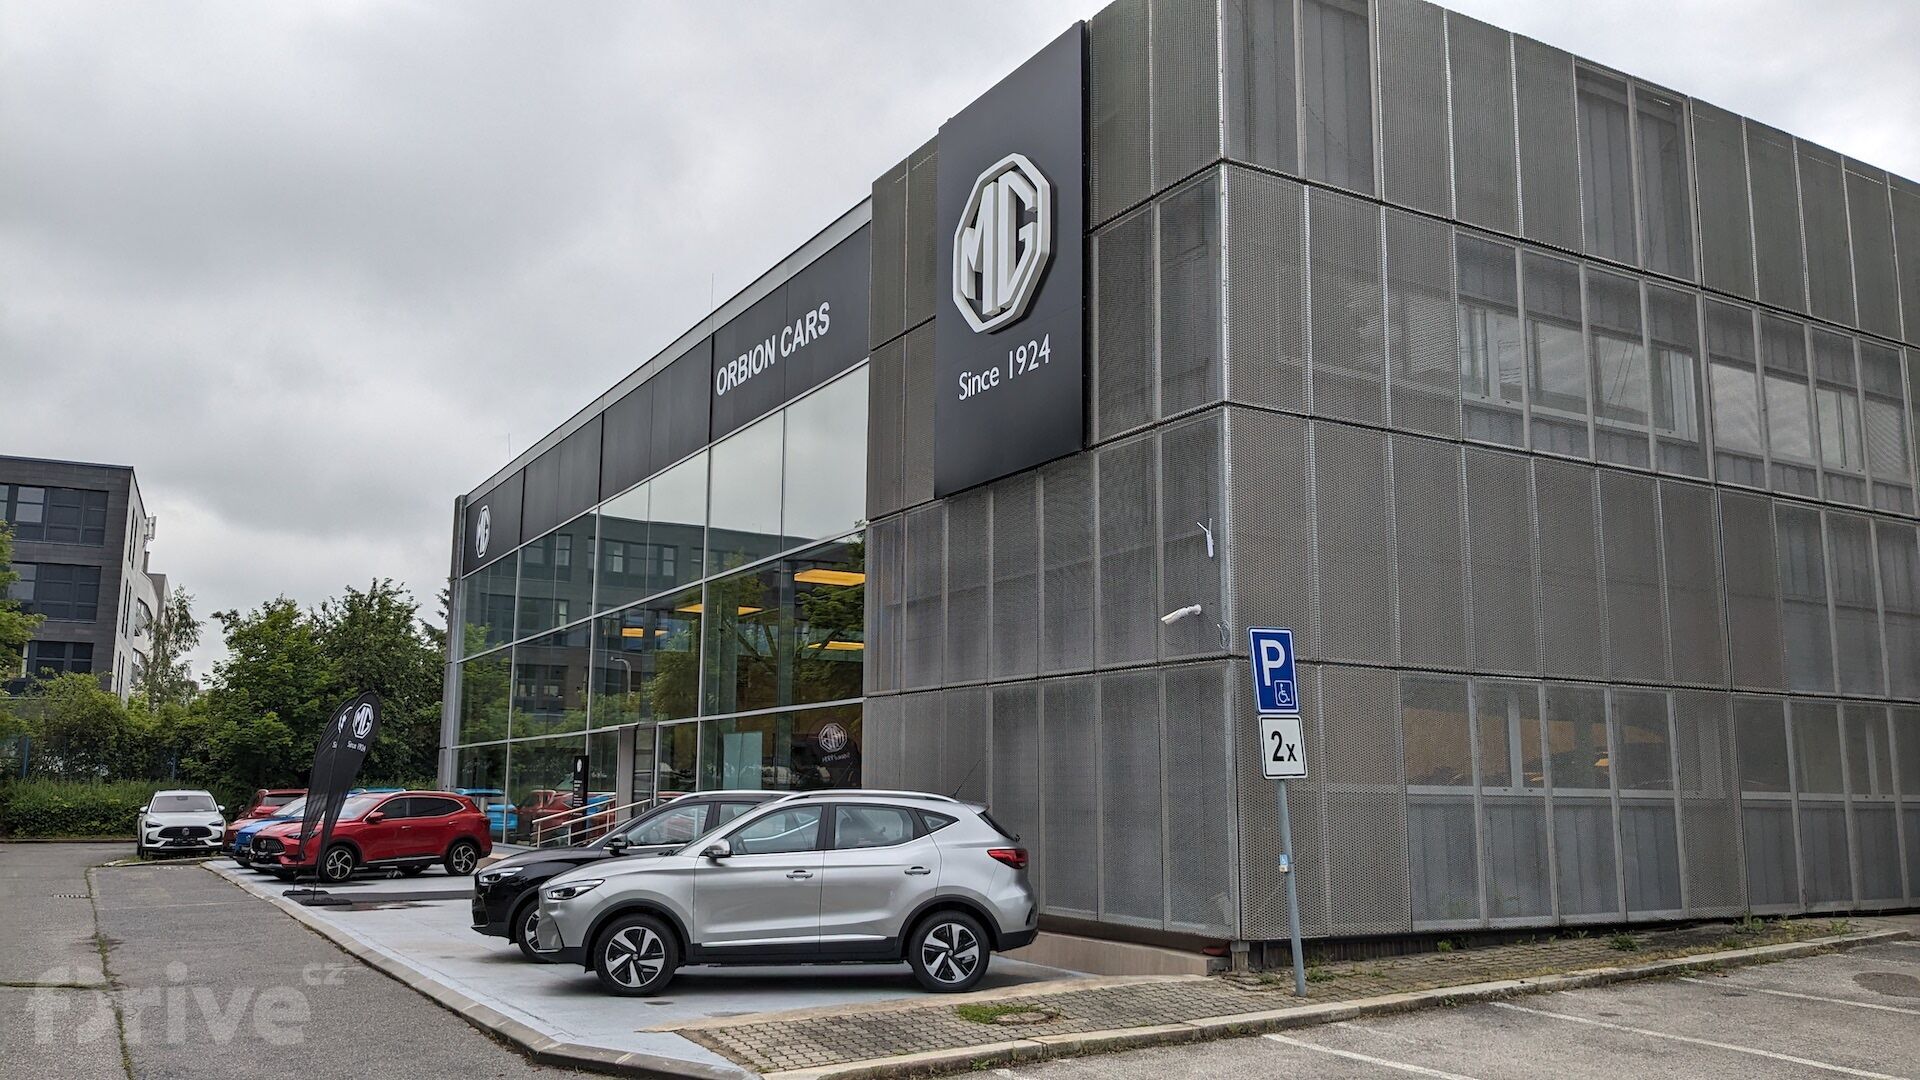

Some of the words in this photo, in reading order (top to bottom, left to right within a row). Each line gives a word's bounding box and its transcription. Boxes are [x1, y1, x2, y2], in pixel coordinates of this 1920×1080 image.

[960, 168, 1039, 318] MG
[716, 334, 776, 397] ORBION
[780, 301, 831, 358] CARS
[958, 364, 1000, 401] Since
[1007, 333, 1051, 380] 1924
[1260, 639, 1285, 686] P
[354, 705, 372, 737] MG
[1271, 730, 1297, 762] 2x
